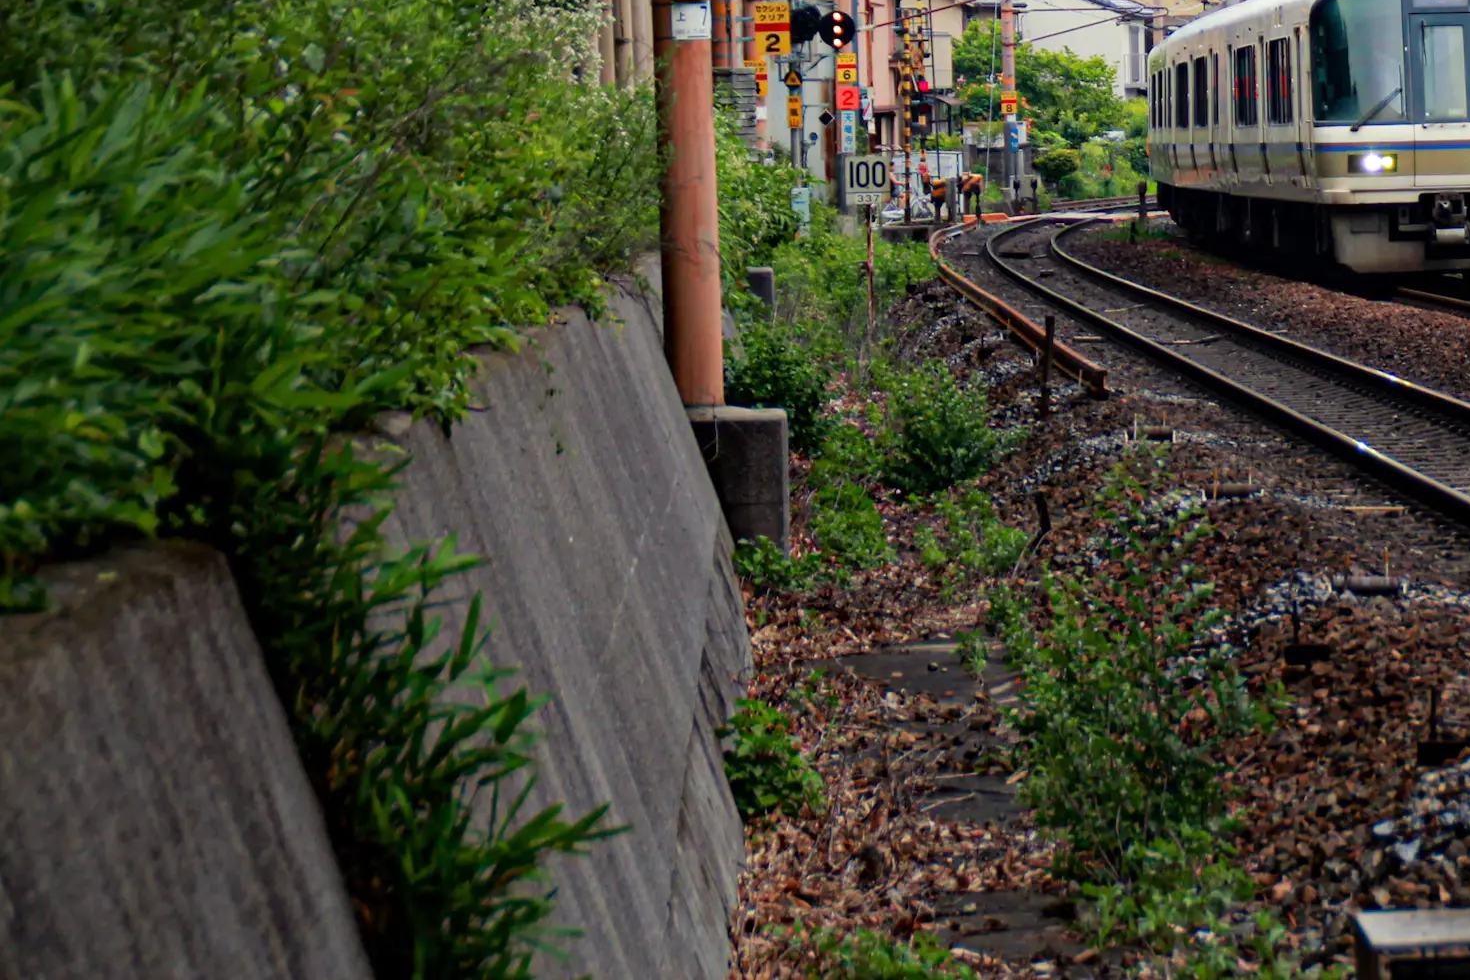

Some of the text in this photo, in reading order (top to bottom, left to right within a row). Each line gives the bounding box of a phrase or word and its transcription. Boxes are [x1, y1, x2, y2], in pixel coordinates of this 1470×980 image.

[755, 5, 788, 13] セクション
[676, 12, 686, 22] 上
[765, 33, 780, 53] 2
[843, 69, 851, 80] 6
[842, 89, 854, 106] 2
[1006, 104, 1013, 113] 8
[850, 161, 886, 188] 100
[857, 194, 880, 203] 337
